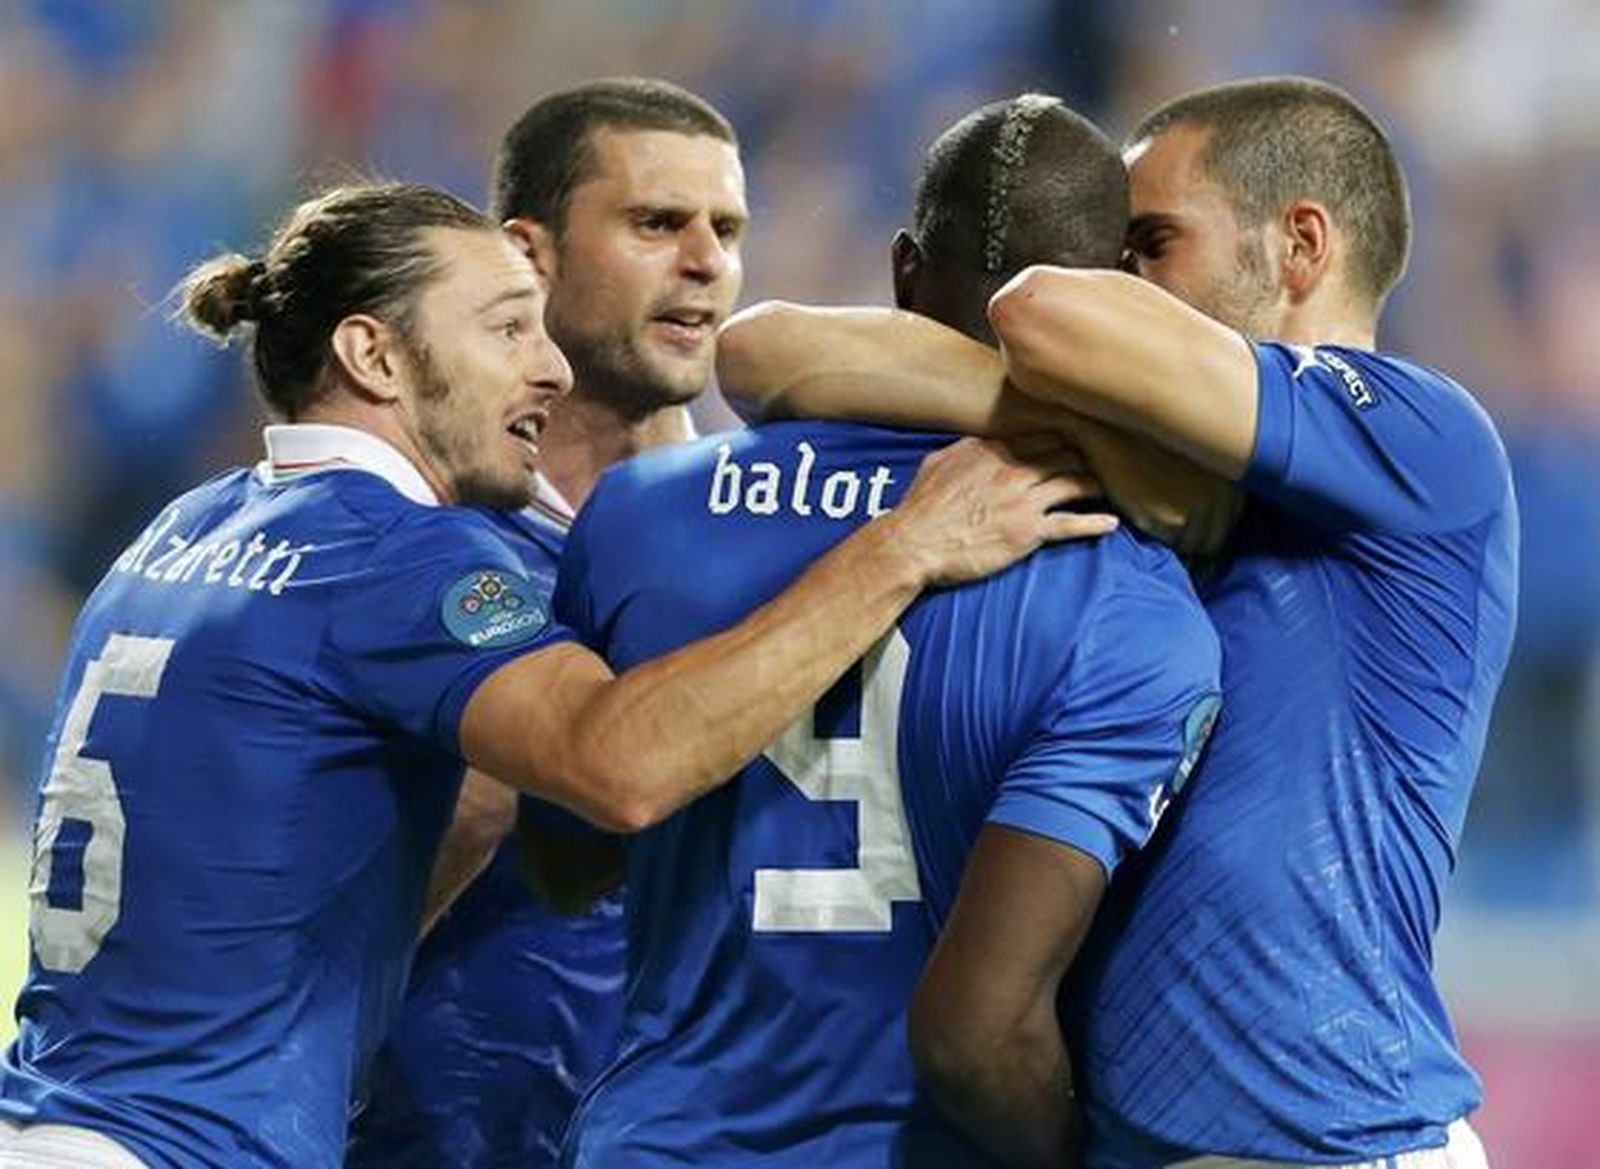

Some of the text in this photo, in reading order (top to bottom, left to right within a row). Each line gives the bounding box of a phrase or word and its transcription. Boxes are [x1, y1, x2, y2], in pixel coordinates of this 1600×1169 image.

[708, 441, 896, 519] balot
[28, 632, 176, 974] 6
[753, 624, 921, 932] 9
